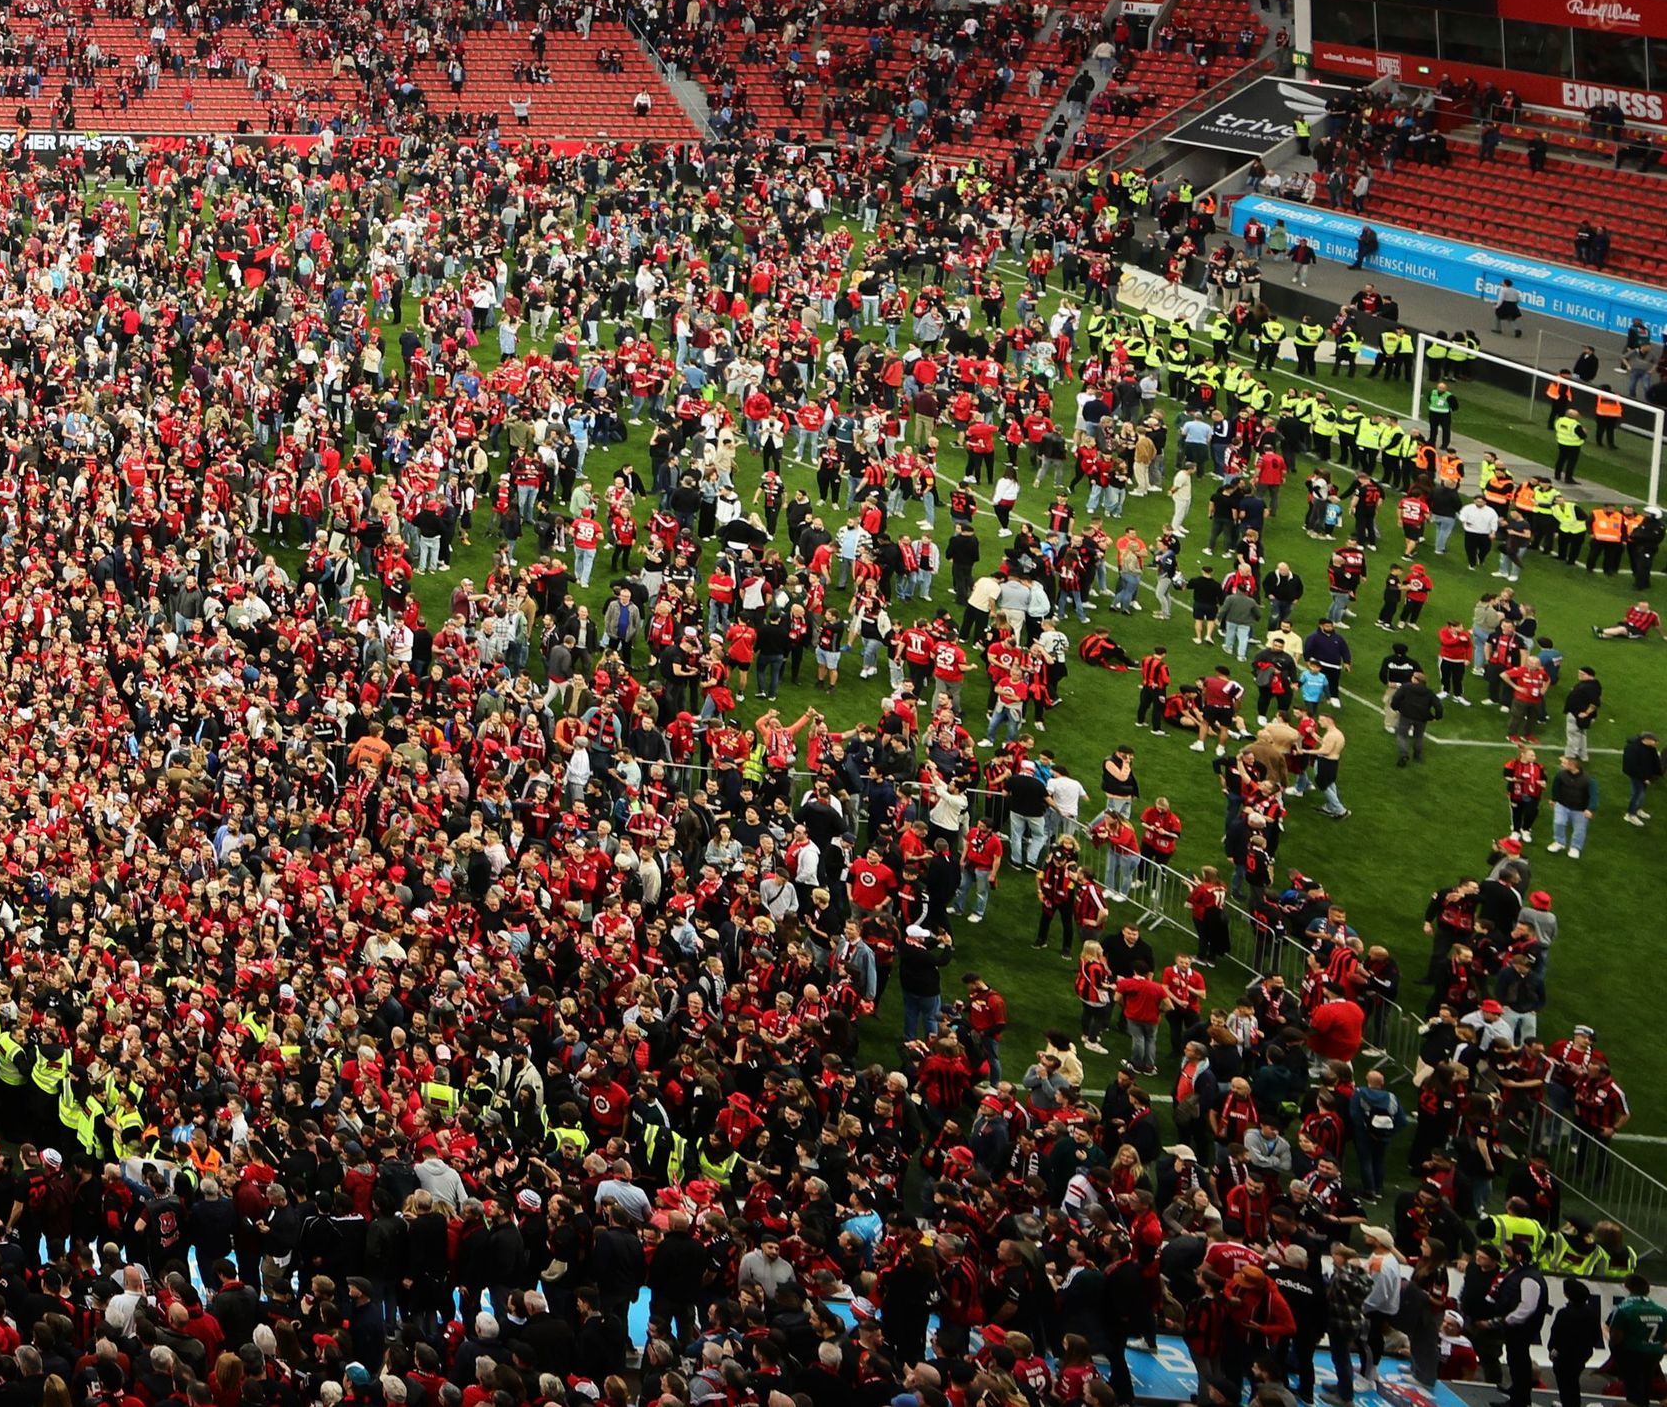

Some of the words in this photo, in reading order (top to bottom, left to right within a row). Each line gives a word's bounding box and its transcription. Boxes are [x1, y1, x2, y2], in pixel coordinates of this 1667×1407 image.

[1125, 3, 1133, 11] A1
[1563, 82, 1663, 120] EXPRESS
[1215, 113, 1296, 137] trive
[1253, 201, 1324, 225] Barmenia
[1326, 243, 1359, 262] EINFAC
[1370, 254, 1440, 282] MENSCHLICH.
[1466, 251, 1553, 279] Barmenia
[1275, 1276, 1313, 1295] adidas
[1646, 1323, 1658, 1342] 7
